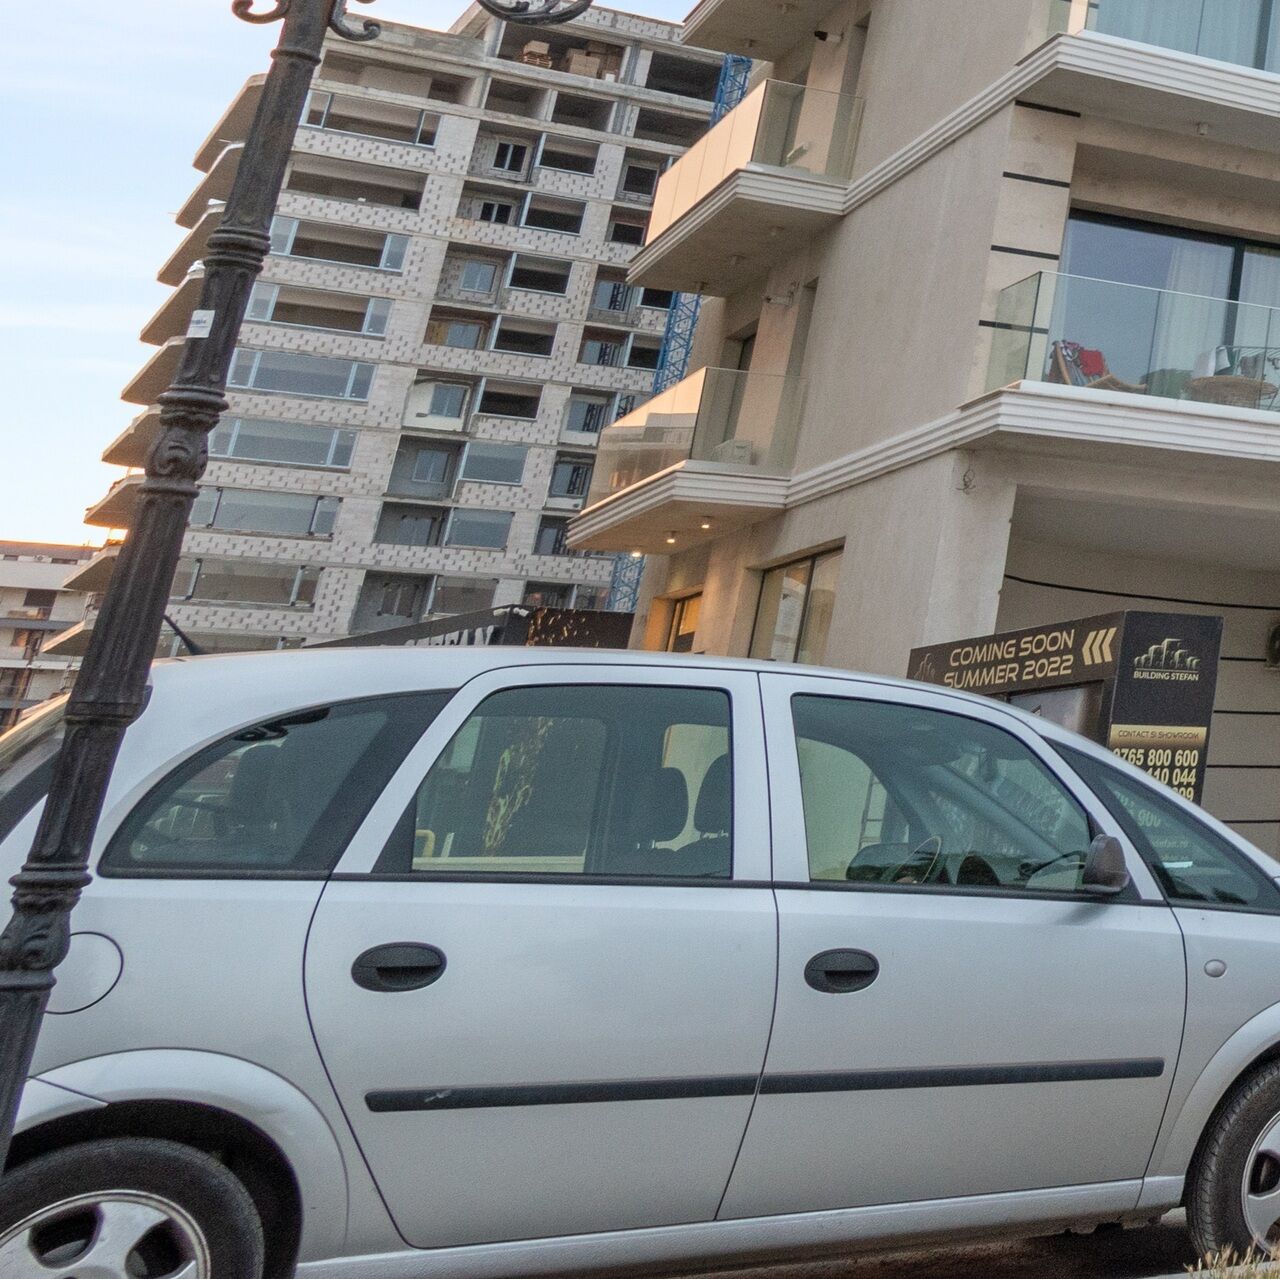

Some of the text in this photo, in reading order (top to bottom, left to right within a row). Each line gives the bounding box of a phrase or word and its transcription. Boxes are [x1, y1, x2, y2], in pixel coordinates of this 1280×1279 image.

[950, 628, 1075, 667] COMING SOON
[944, 654, 1074, 689] SUMMER 2022
[1133, 671, 1199, 681] BUILDING STEFAN
[1118, 729, 1149, 738] CONTACT
[1158, 731, 1199, 739] SHOWROOM
[1147, 748, 1172, 767] 800
[1174, 749, 1199, 767] 600
[1172, 768, 1196, 786] 044
